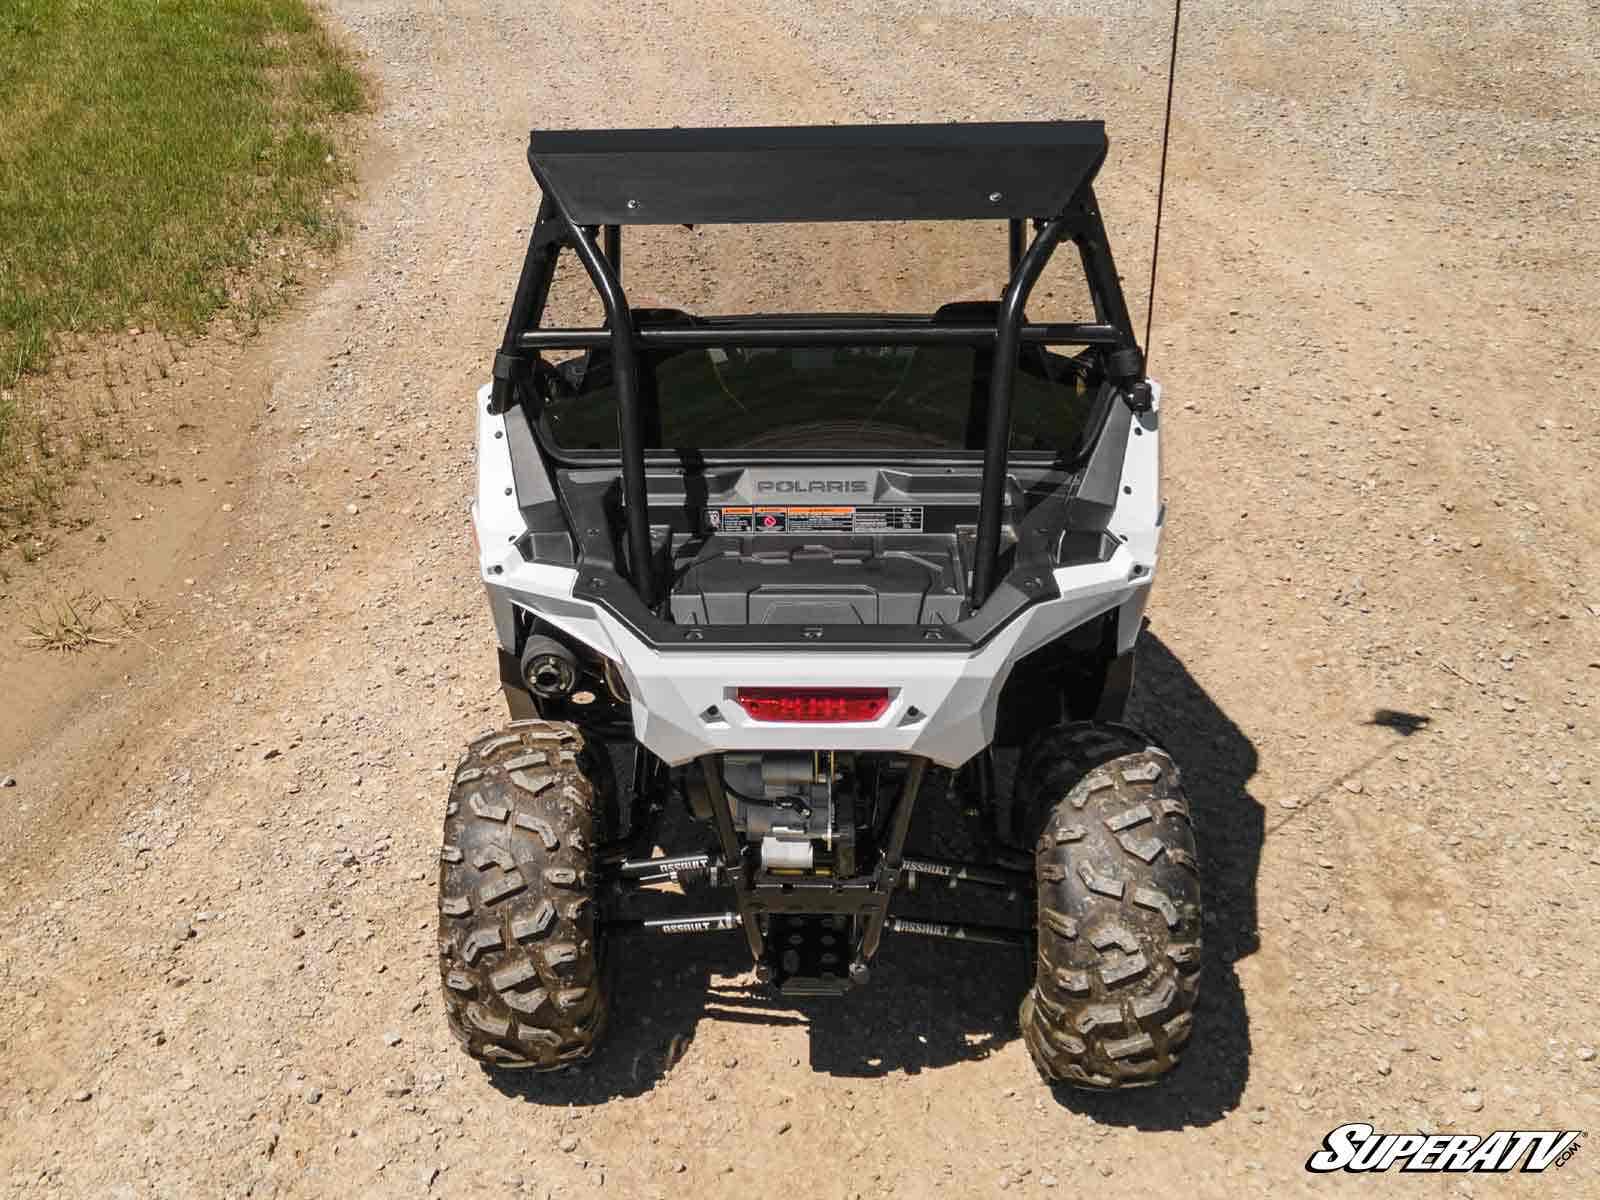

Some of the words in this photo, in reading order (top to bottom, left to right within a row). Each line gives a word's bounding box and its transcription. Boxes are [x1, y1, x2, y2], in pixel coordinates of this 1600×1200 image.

[757, 480, 868, 494] POLARIS
[660, 859, 708, 873] ASSAULT
[662, 921, 711, 935] ASSAULT
